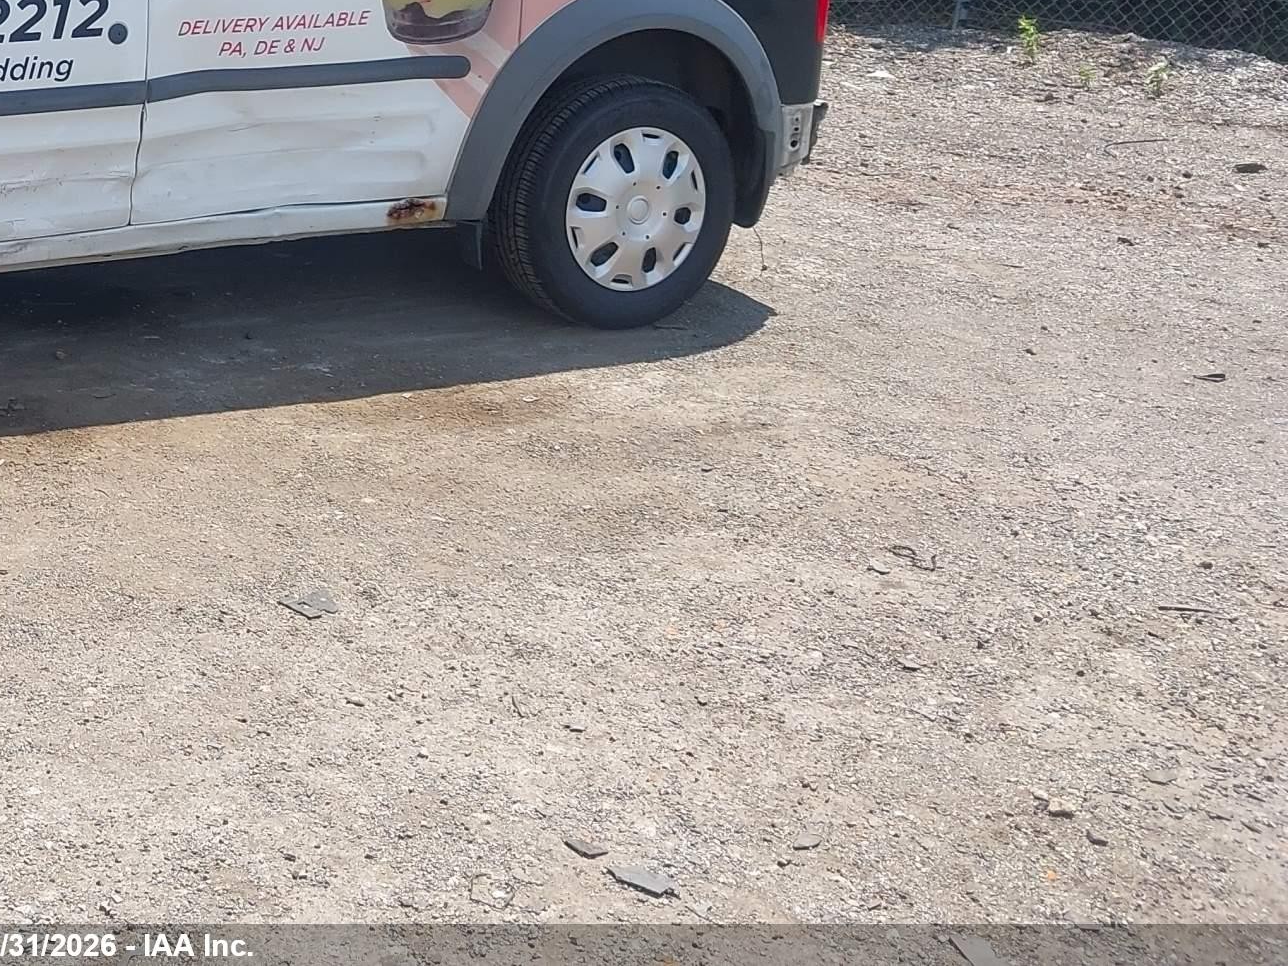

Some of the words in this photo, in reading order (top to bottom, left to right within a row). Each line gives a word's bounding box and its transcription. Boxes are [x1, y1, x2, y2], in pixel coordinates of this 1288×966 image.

[178, 17, 269, 37] DELIVERY
[271, 10, 371, 31] AVAILABLE
[219, 41, 246, 59] PA,
[254, 40, 281, 56] DE
[283, 38, 296, 53] &
[300, 37, 325, 52] NJ
